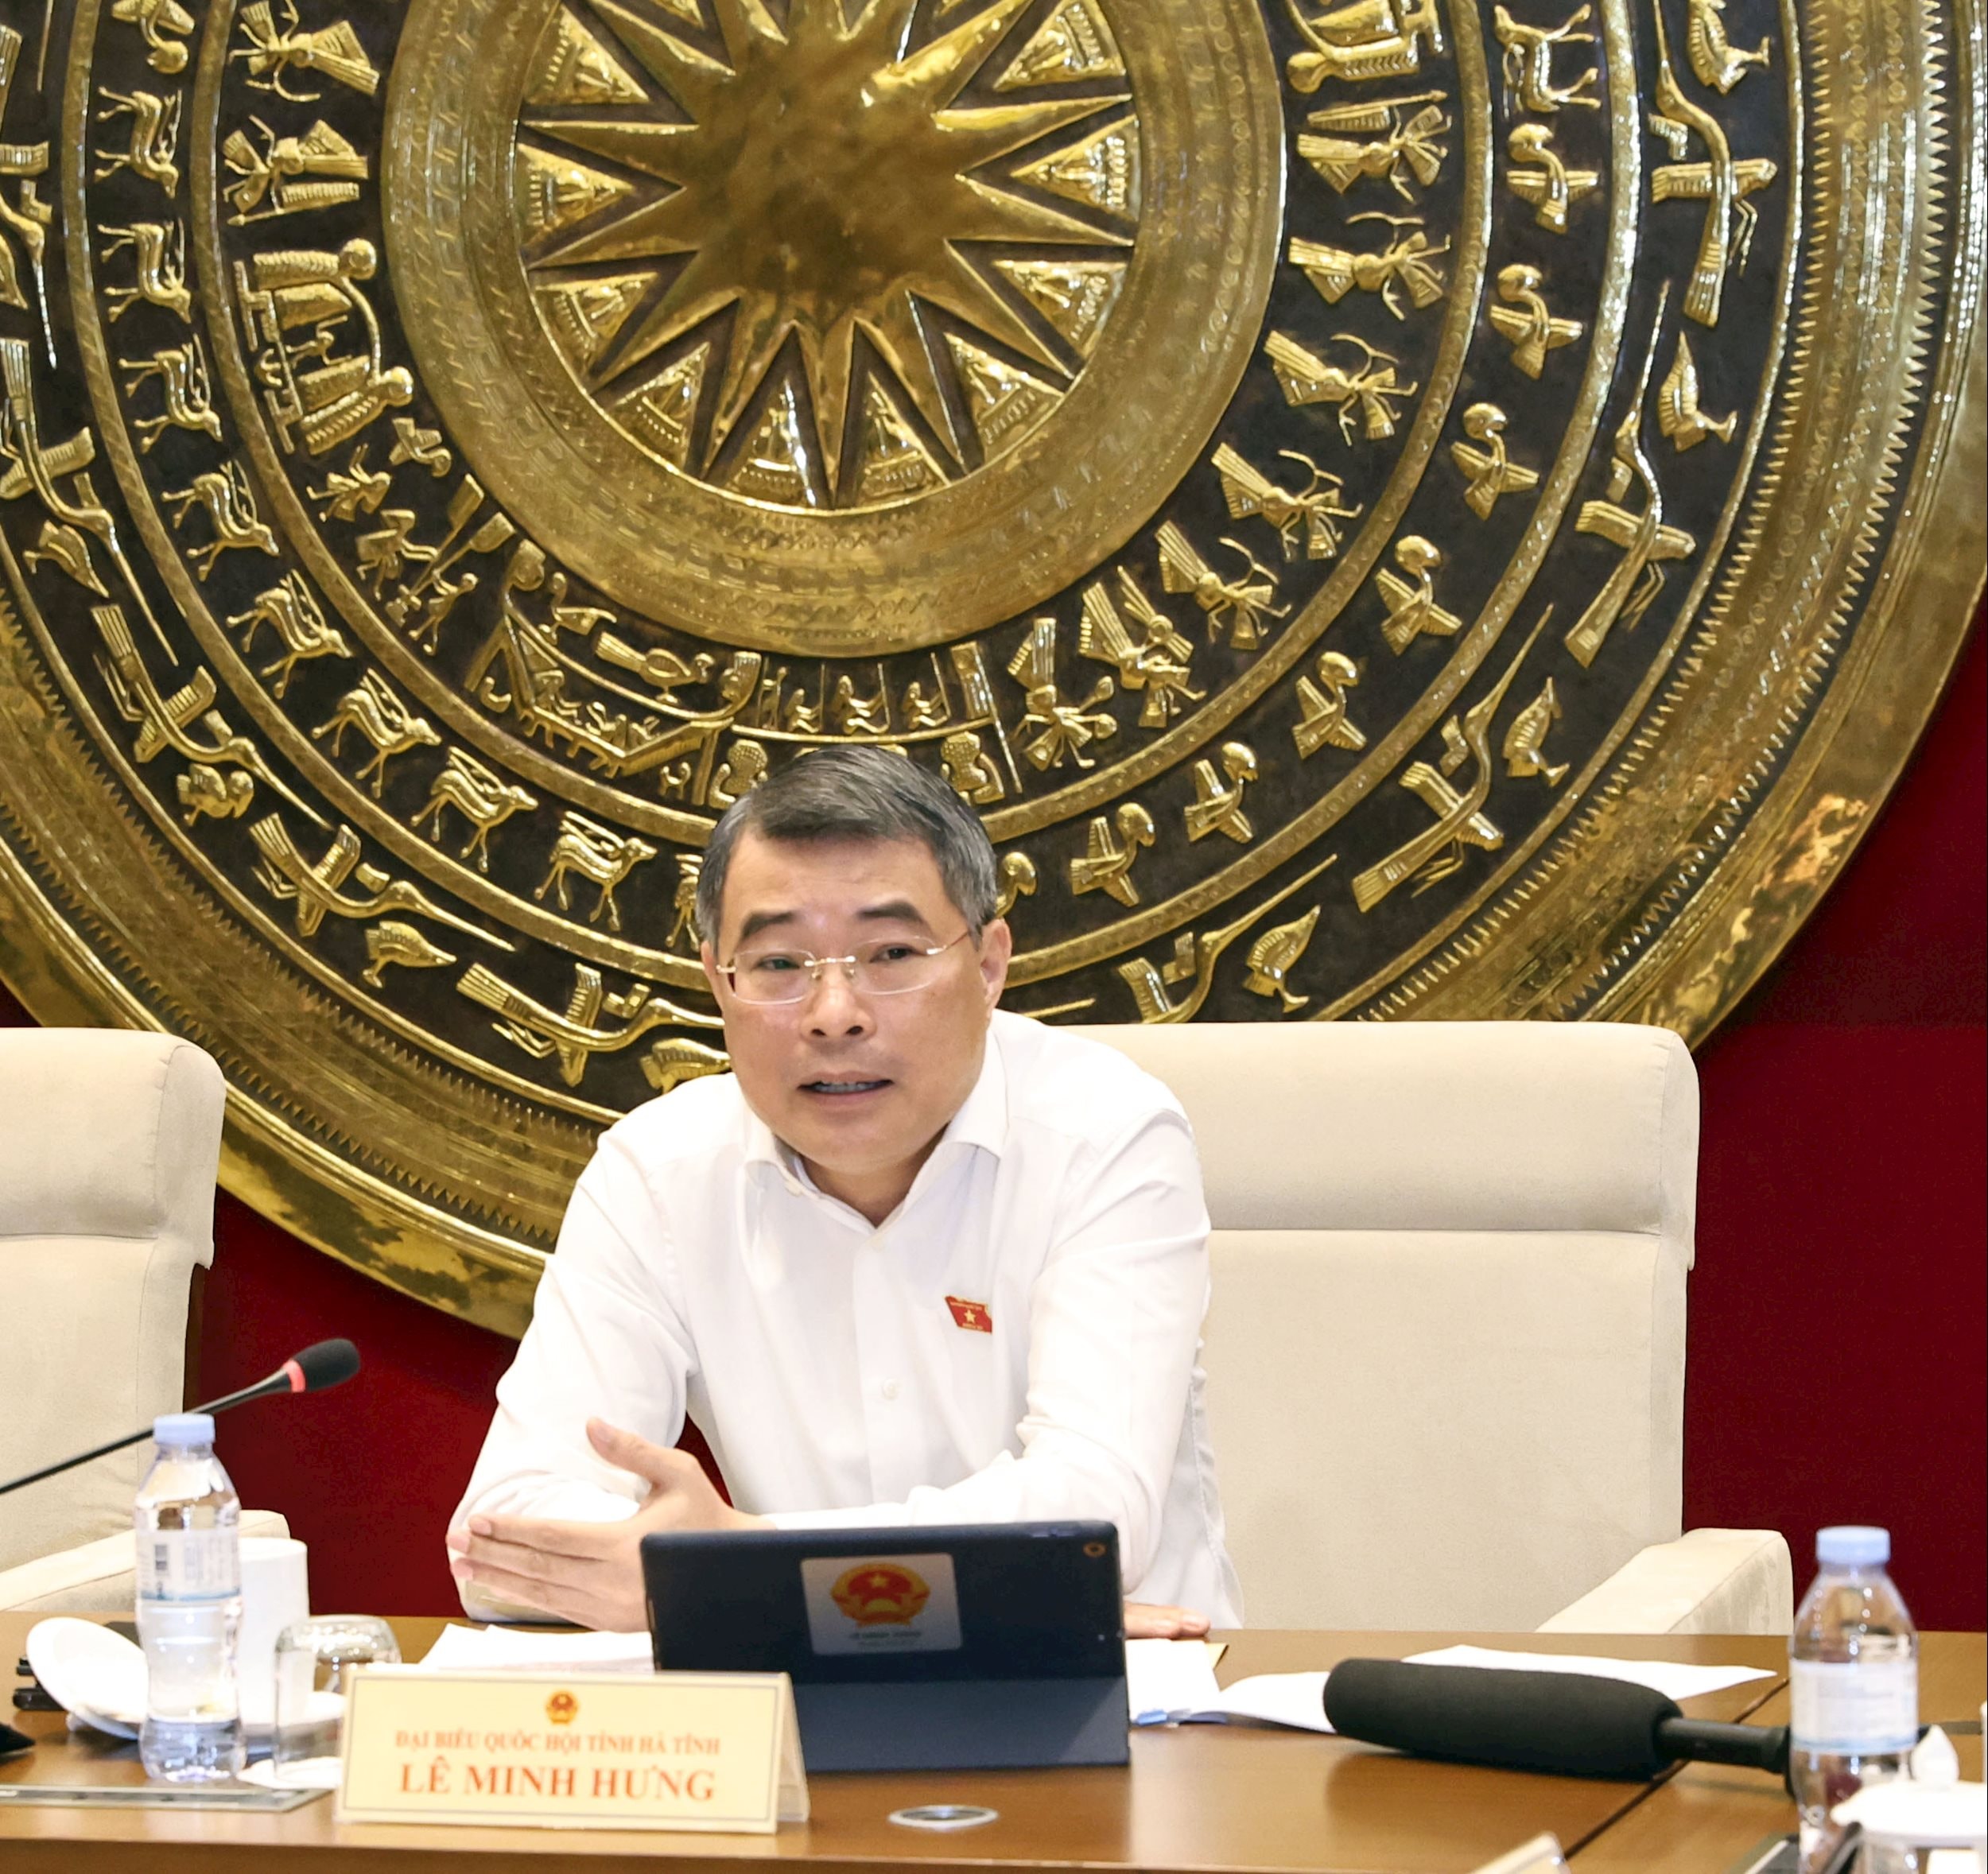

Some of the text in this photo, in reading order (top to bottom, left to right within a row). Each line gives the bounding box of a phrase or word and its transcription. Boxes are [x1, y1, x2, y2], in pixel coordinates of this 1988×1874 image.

[400, 1754, 716, 1802] LÊ MINH HƯNG
